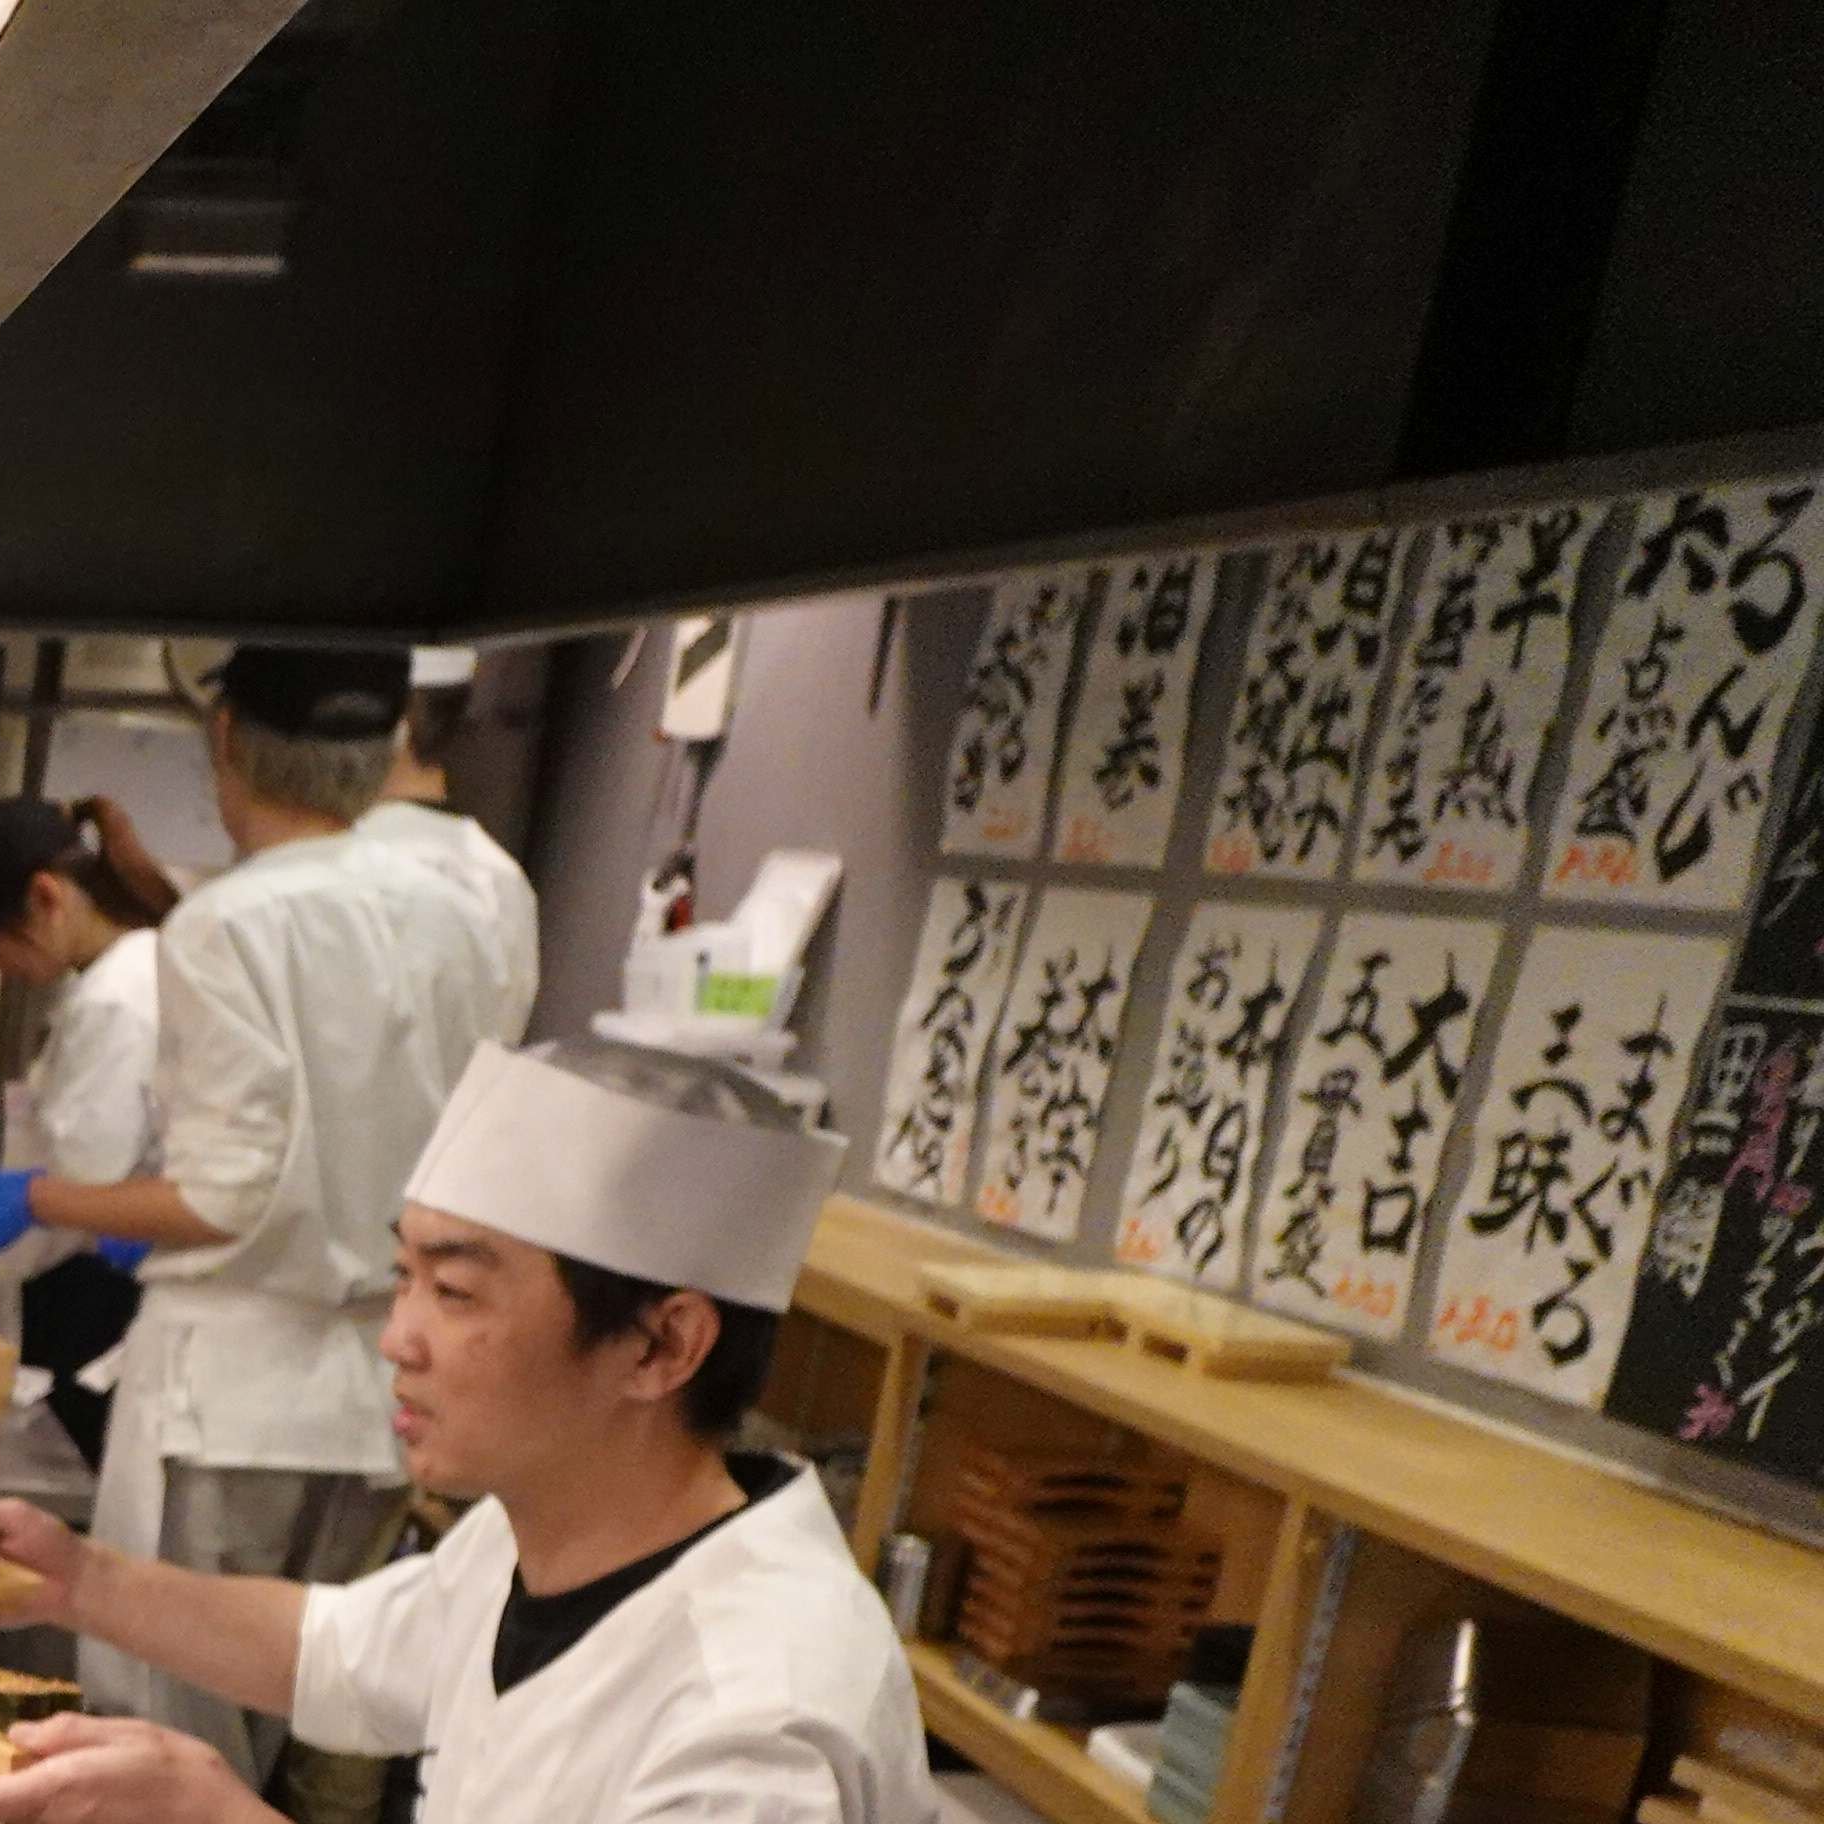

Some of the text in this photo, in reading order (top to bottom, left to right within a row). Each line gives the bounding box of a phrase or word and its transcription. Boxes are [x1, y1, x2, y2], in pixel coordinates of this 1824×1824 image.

[1175, 936, 1289, 1280] 本日の
[1361, 947, 1471, 1256] 大吉
[1531, 993, 1676, 1367] まぐろ
